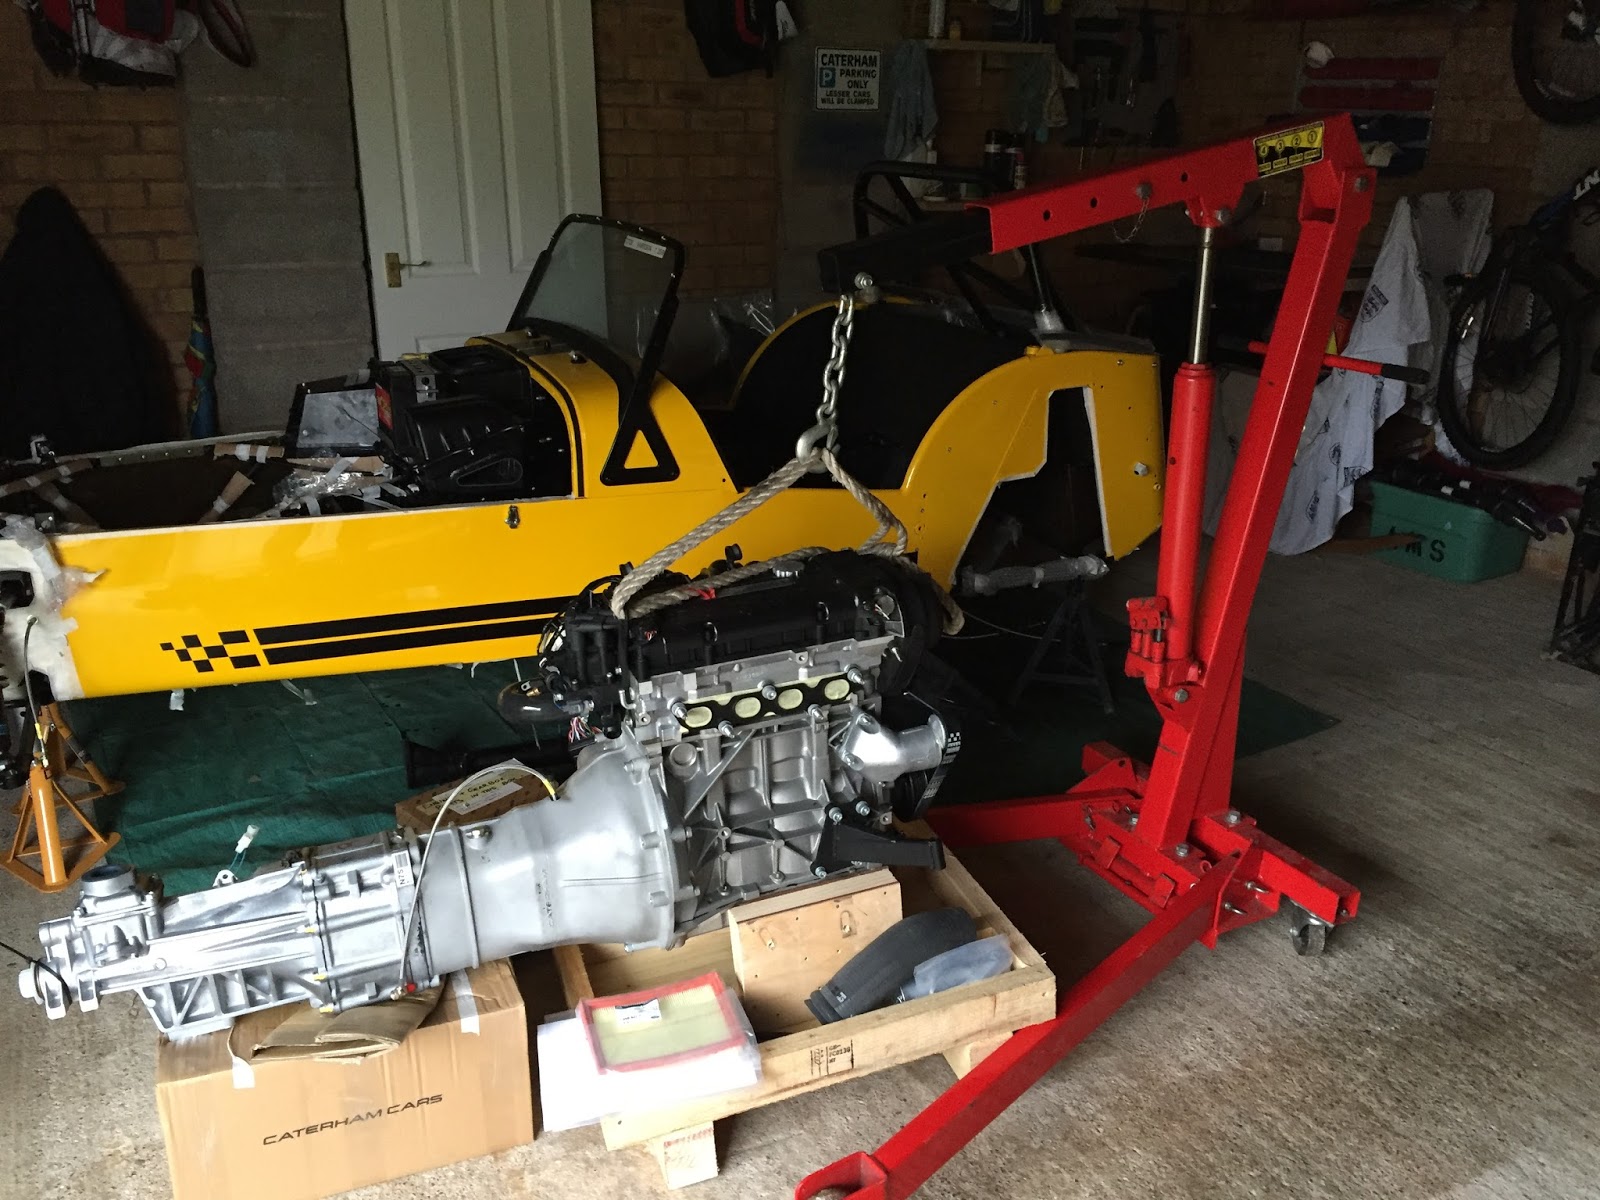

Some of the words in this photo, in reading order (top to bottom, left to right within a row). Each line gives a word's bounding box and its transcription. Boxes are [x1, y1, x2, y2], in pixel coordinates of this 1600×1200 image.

[821, 54, 877, 67] CATERHAM
[822, 69, 833, 86] P
[839, 69, 877, 78] PARKING
[847, 80, 869, 89] ONLY
[263, 1109, 383, 1145] CATERHAM
[387, 1094, 443, 1115] CARS
